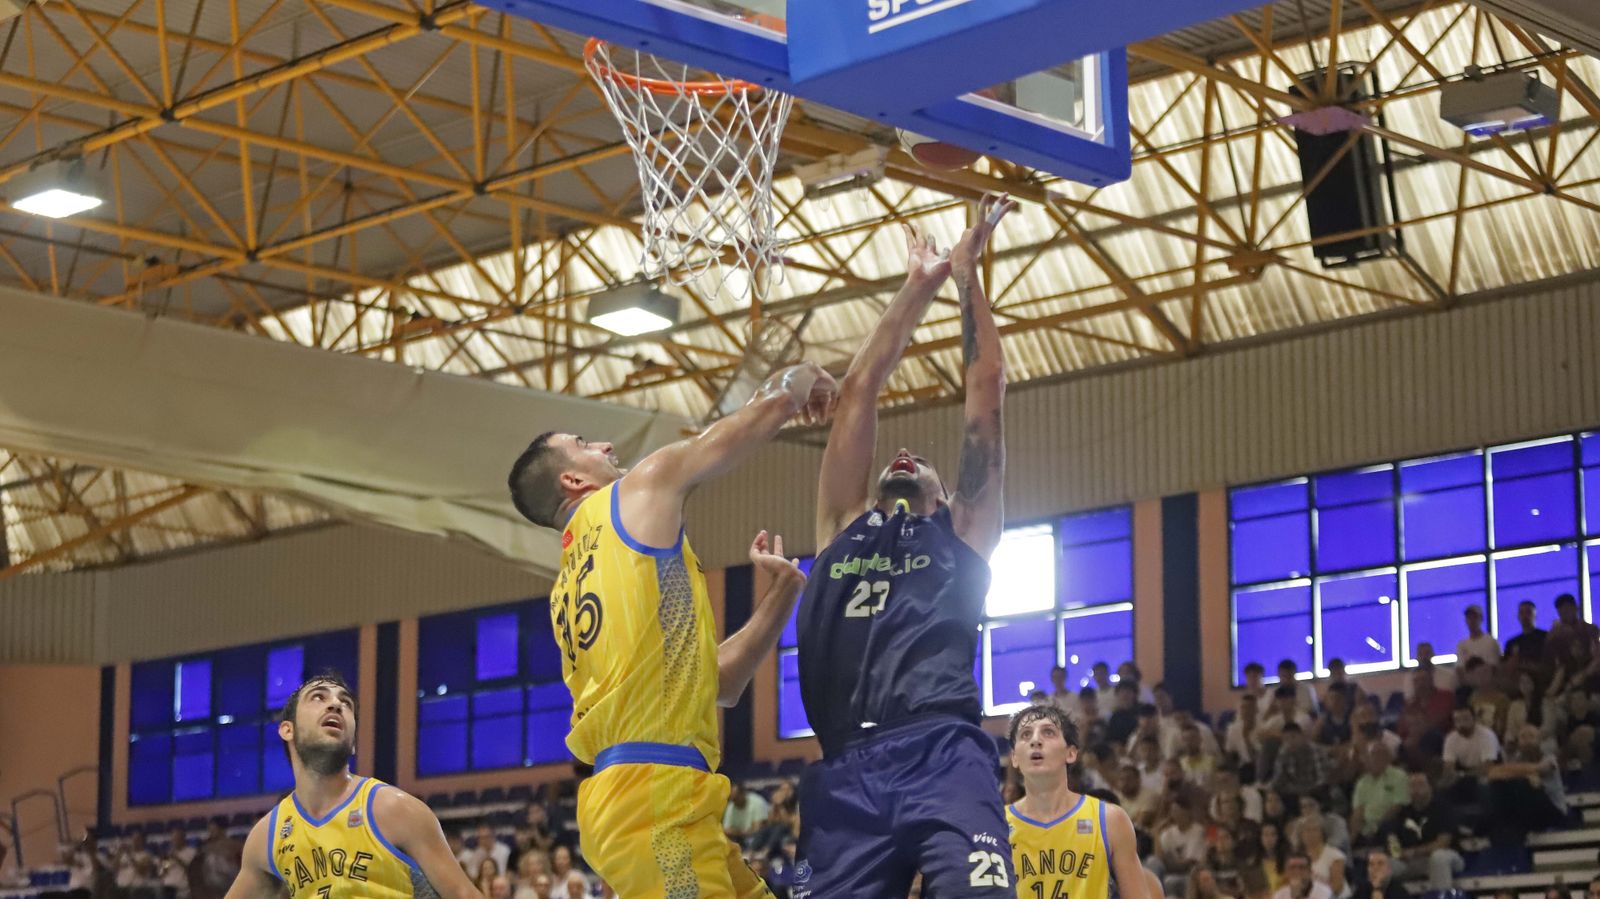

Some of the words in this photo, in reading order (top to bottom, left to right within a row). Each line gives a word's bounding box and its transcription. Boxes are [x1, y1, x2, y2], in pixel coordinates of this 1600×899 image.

[968, 850, 1009, 888] 23
[1015, 849, 1095, 884] ANOE
[1030, 879, 1069, 899] 14
